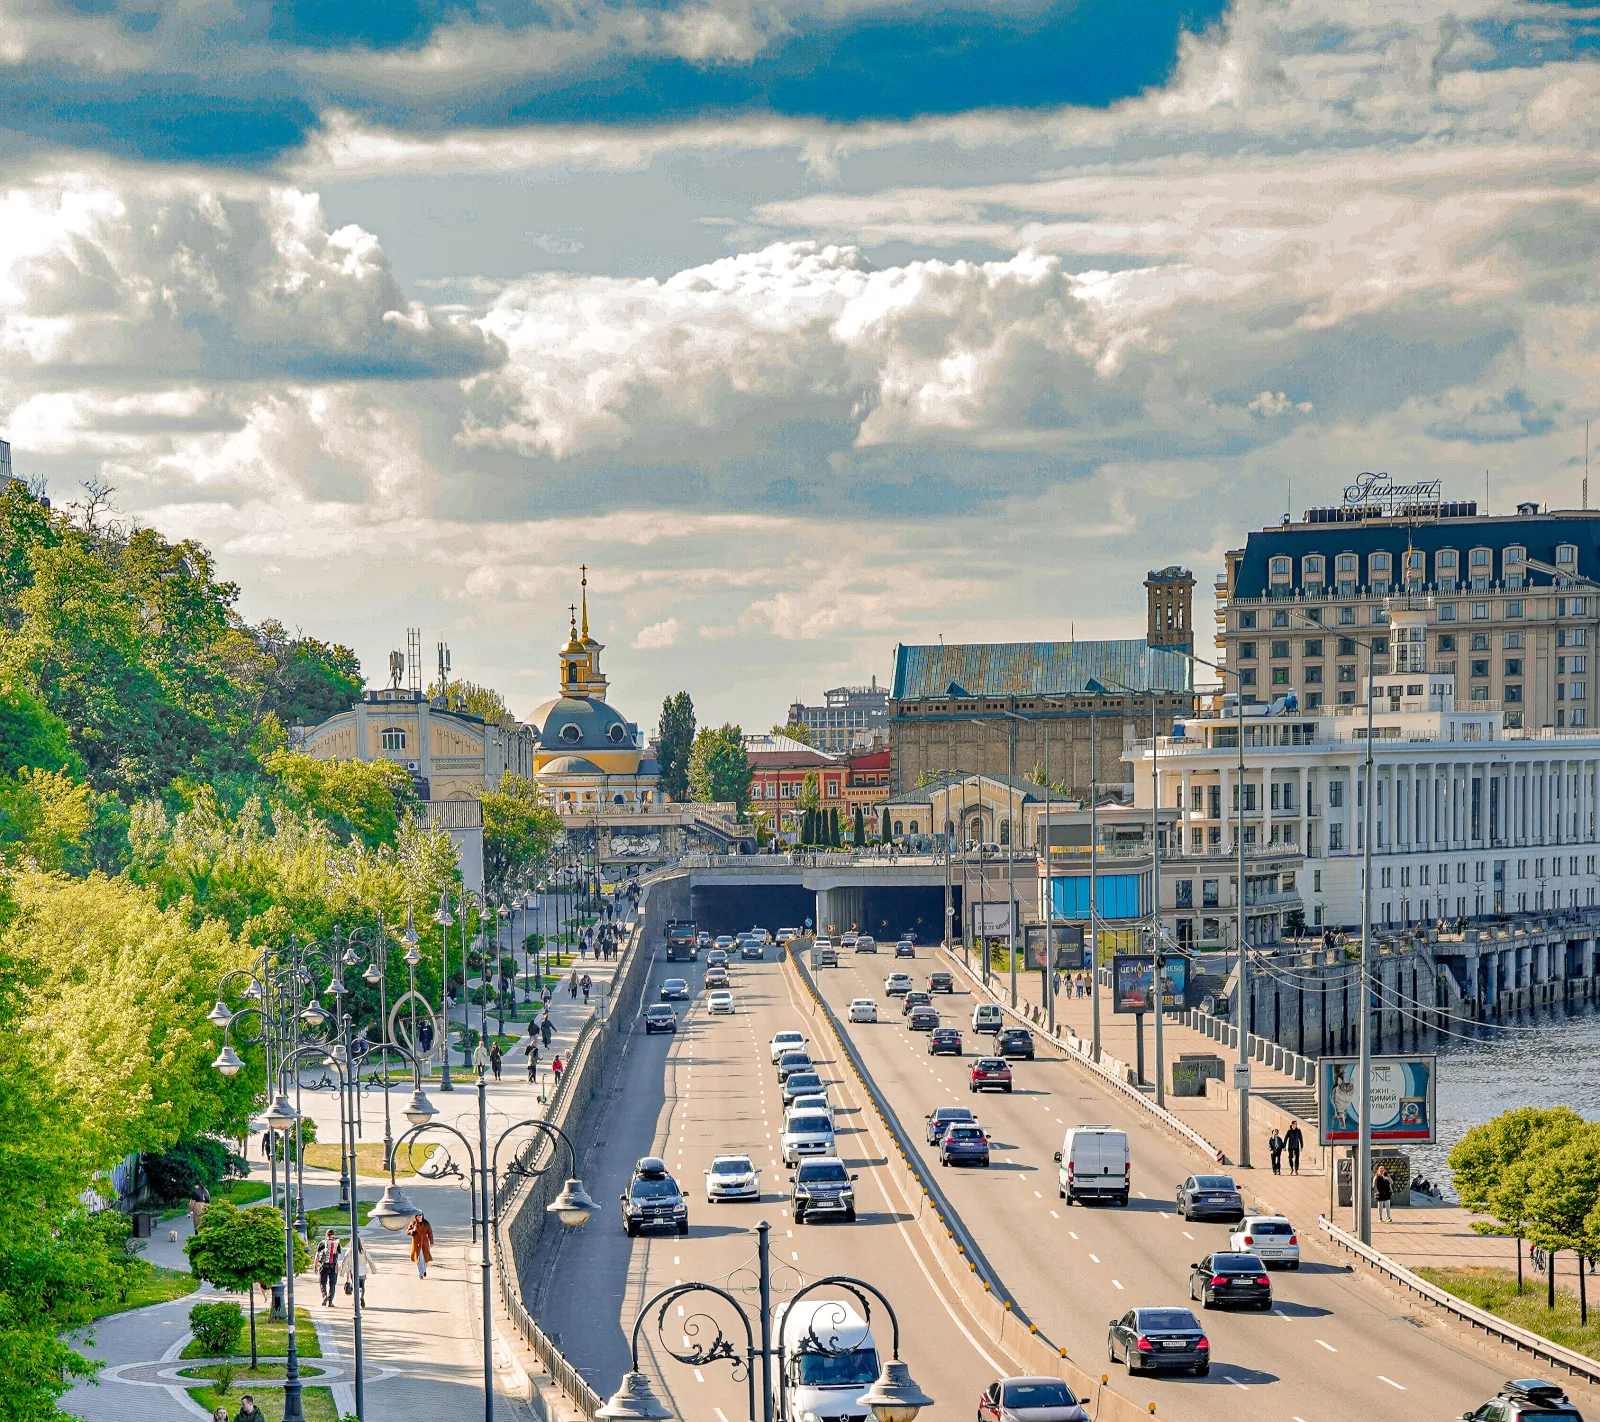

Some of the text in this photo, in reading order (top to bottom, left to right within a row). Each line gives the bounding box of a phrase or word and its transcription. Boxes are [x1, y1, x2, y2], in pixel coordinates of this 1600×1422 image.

[1344, 472, 1442, 502] Fairmont
[1120, 966, 1130, 974] ЦЕ
[1370, 1094, 1397, 1102] ДИМИЙ
